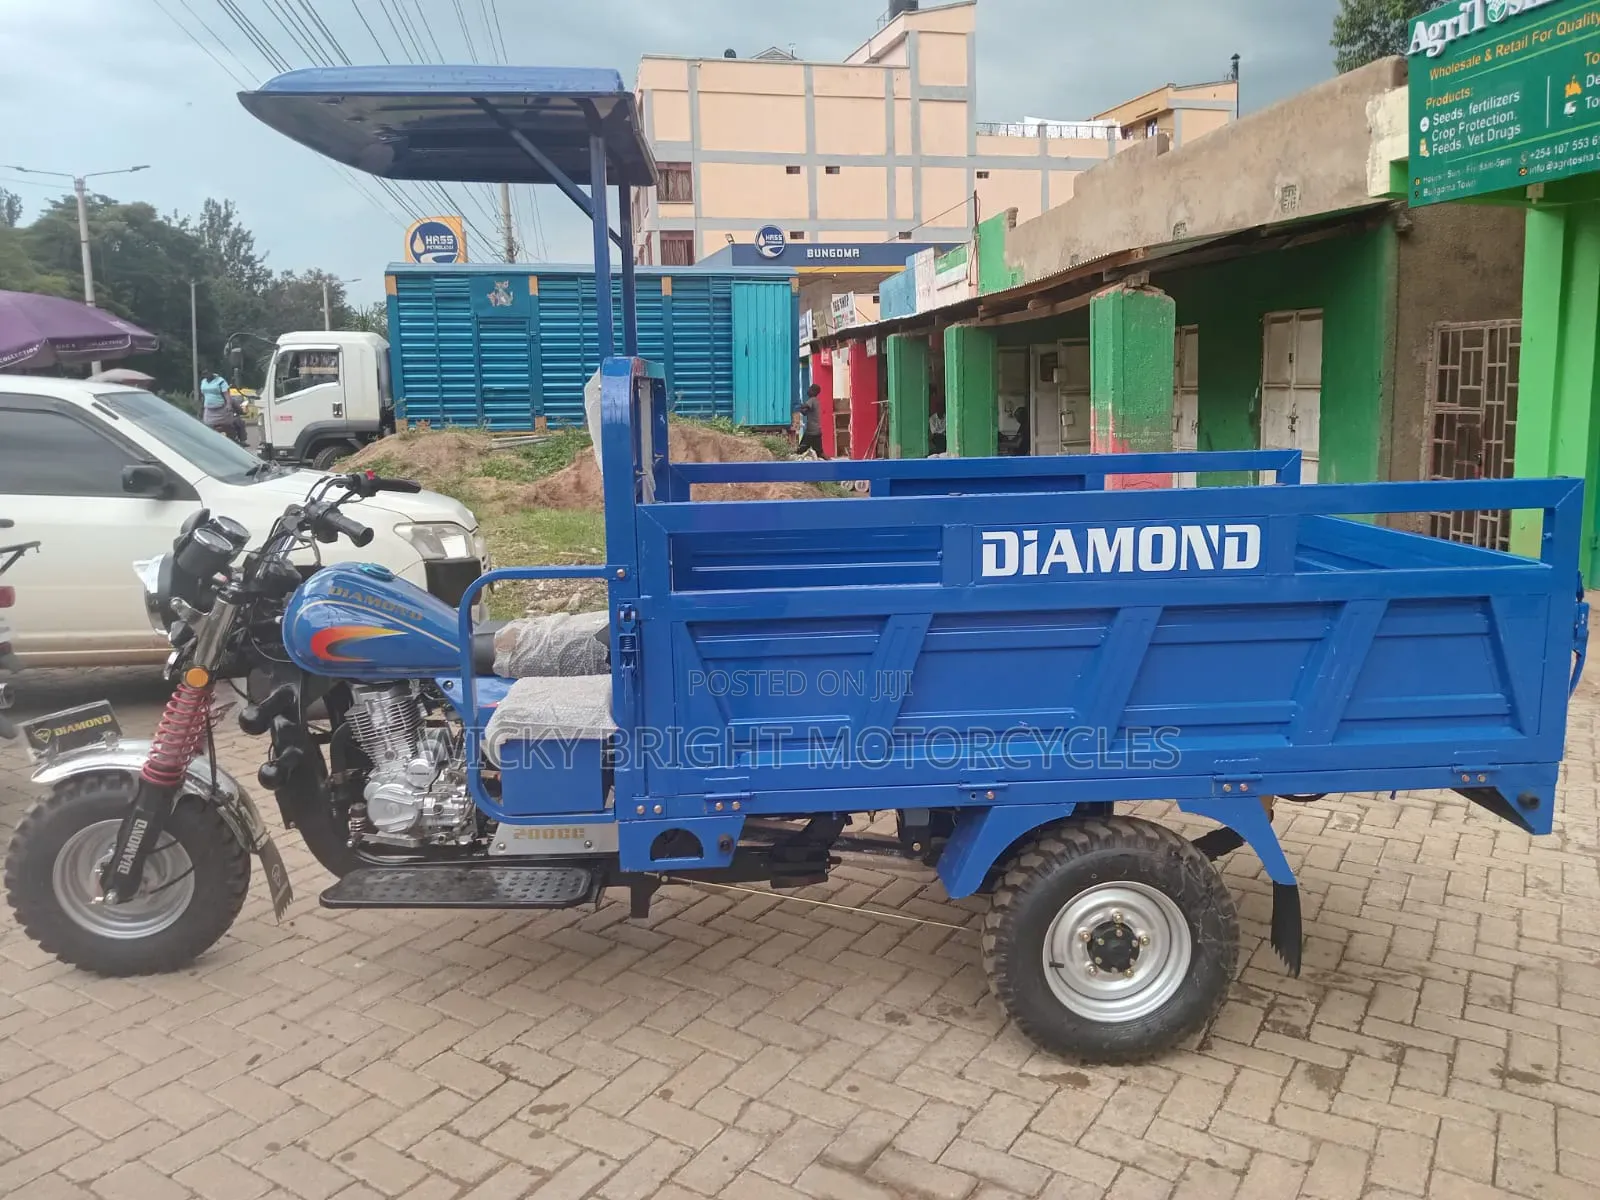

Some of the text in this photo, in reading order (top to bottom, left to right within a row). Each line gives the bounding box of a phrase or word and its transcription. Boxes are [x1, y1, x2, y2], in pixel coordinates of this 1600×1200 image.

[1430, 12, 1600, 80] Wholesale & Retail For Quality
[1469, 91, 1520, 115] fertilizers
[1432, 128, 1456, 142] Crop
[1468, 134, 1485, 147] Vet
[1487, 124, 1521, 142] Drugs
[1530, 147, 1551, 160] +254
[1554, 142, 1569, 155] 107
[1572, 137, 1589, 151] 553
[807, 248, 860, 258] BUNGOMA
[981, 524, 1261, 577] DIAMOND
[53, 714, 113, 736] DIAMOND
[117, 819, 148, 876] DIAMOND
